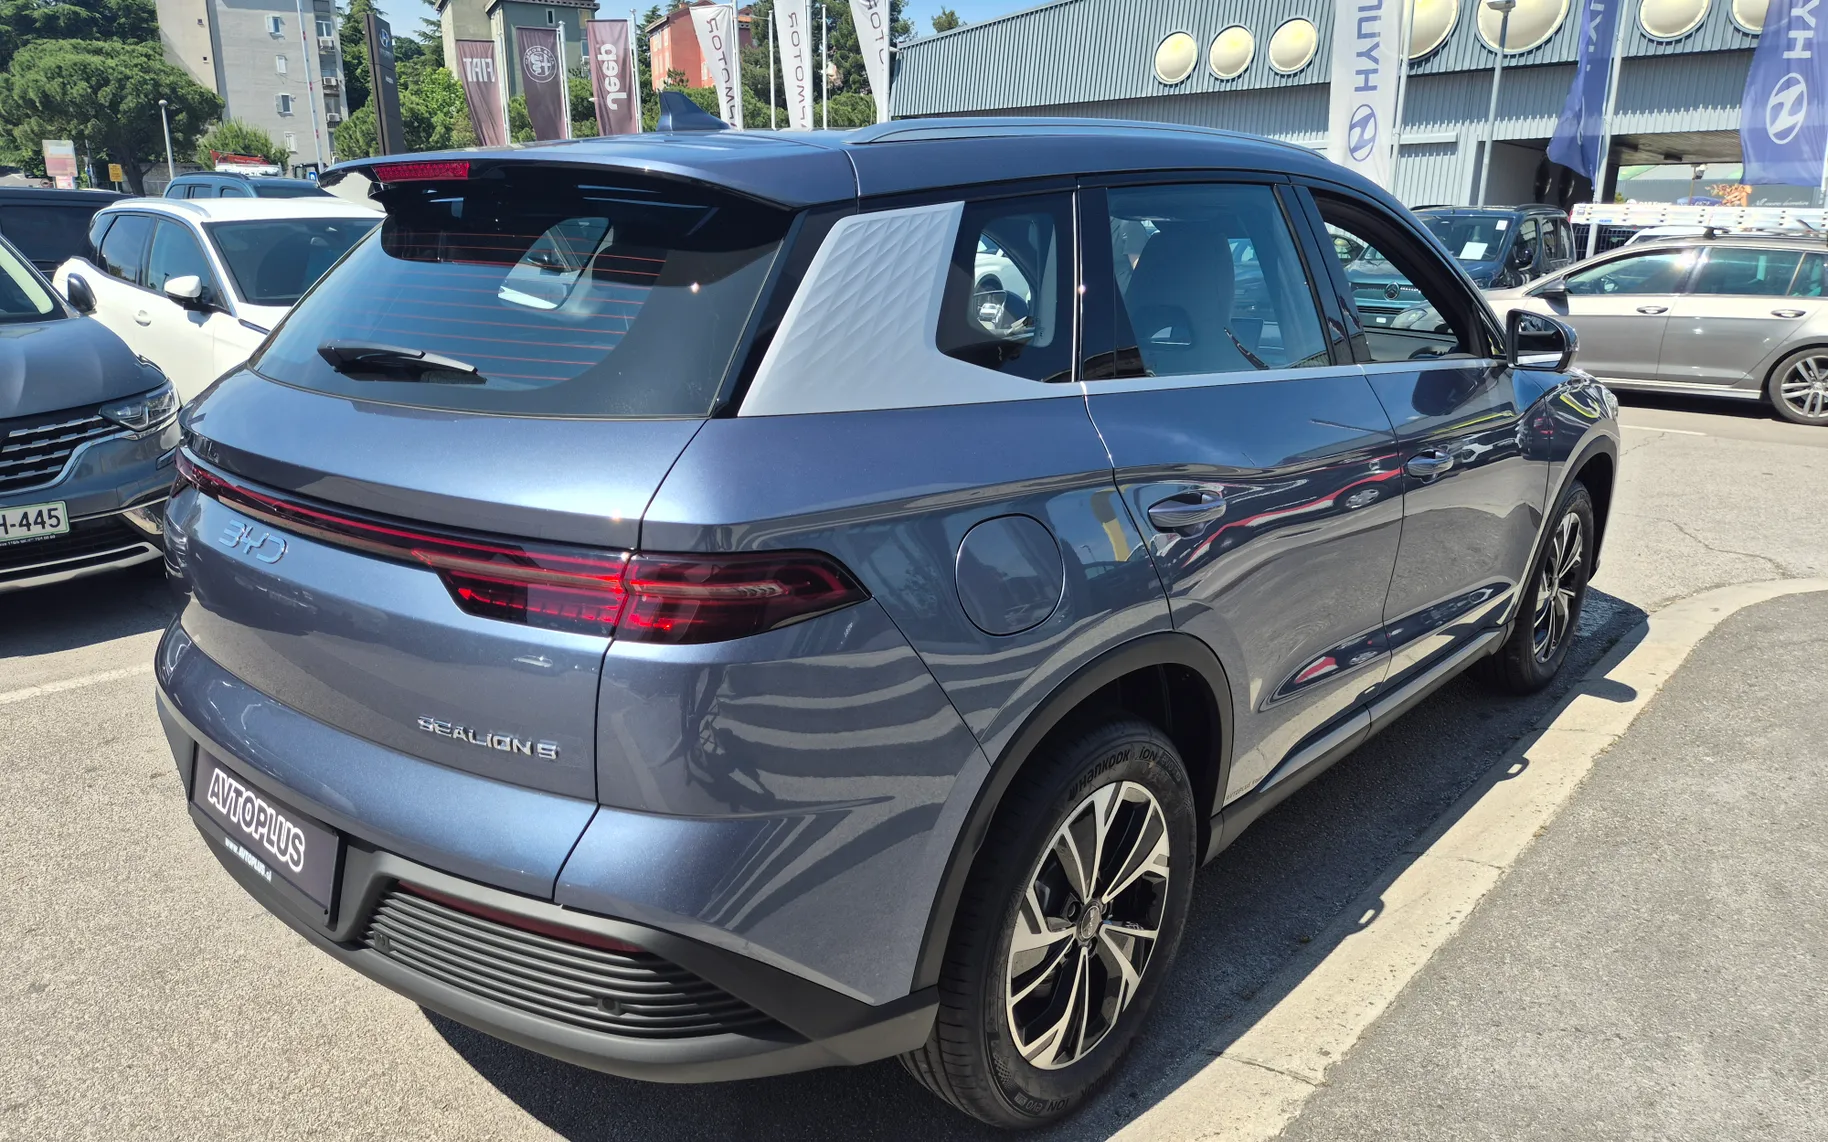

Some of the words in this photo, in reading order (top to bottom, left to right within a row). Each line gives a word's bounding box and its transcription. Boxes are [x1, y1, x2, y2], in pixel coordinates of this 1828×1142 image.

[219, 519, 288, 565] BYD
[417, 714, 533, 756] SEALION
[207, 767, 305, 873] AVTOPLUS
